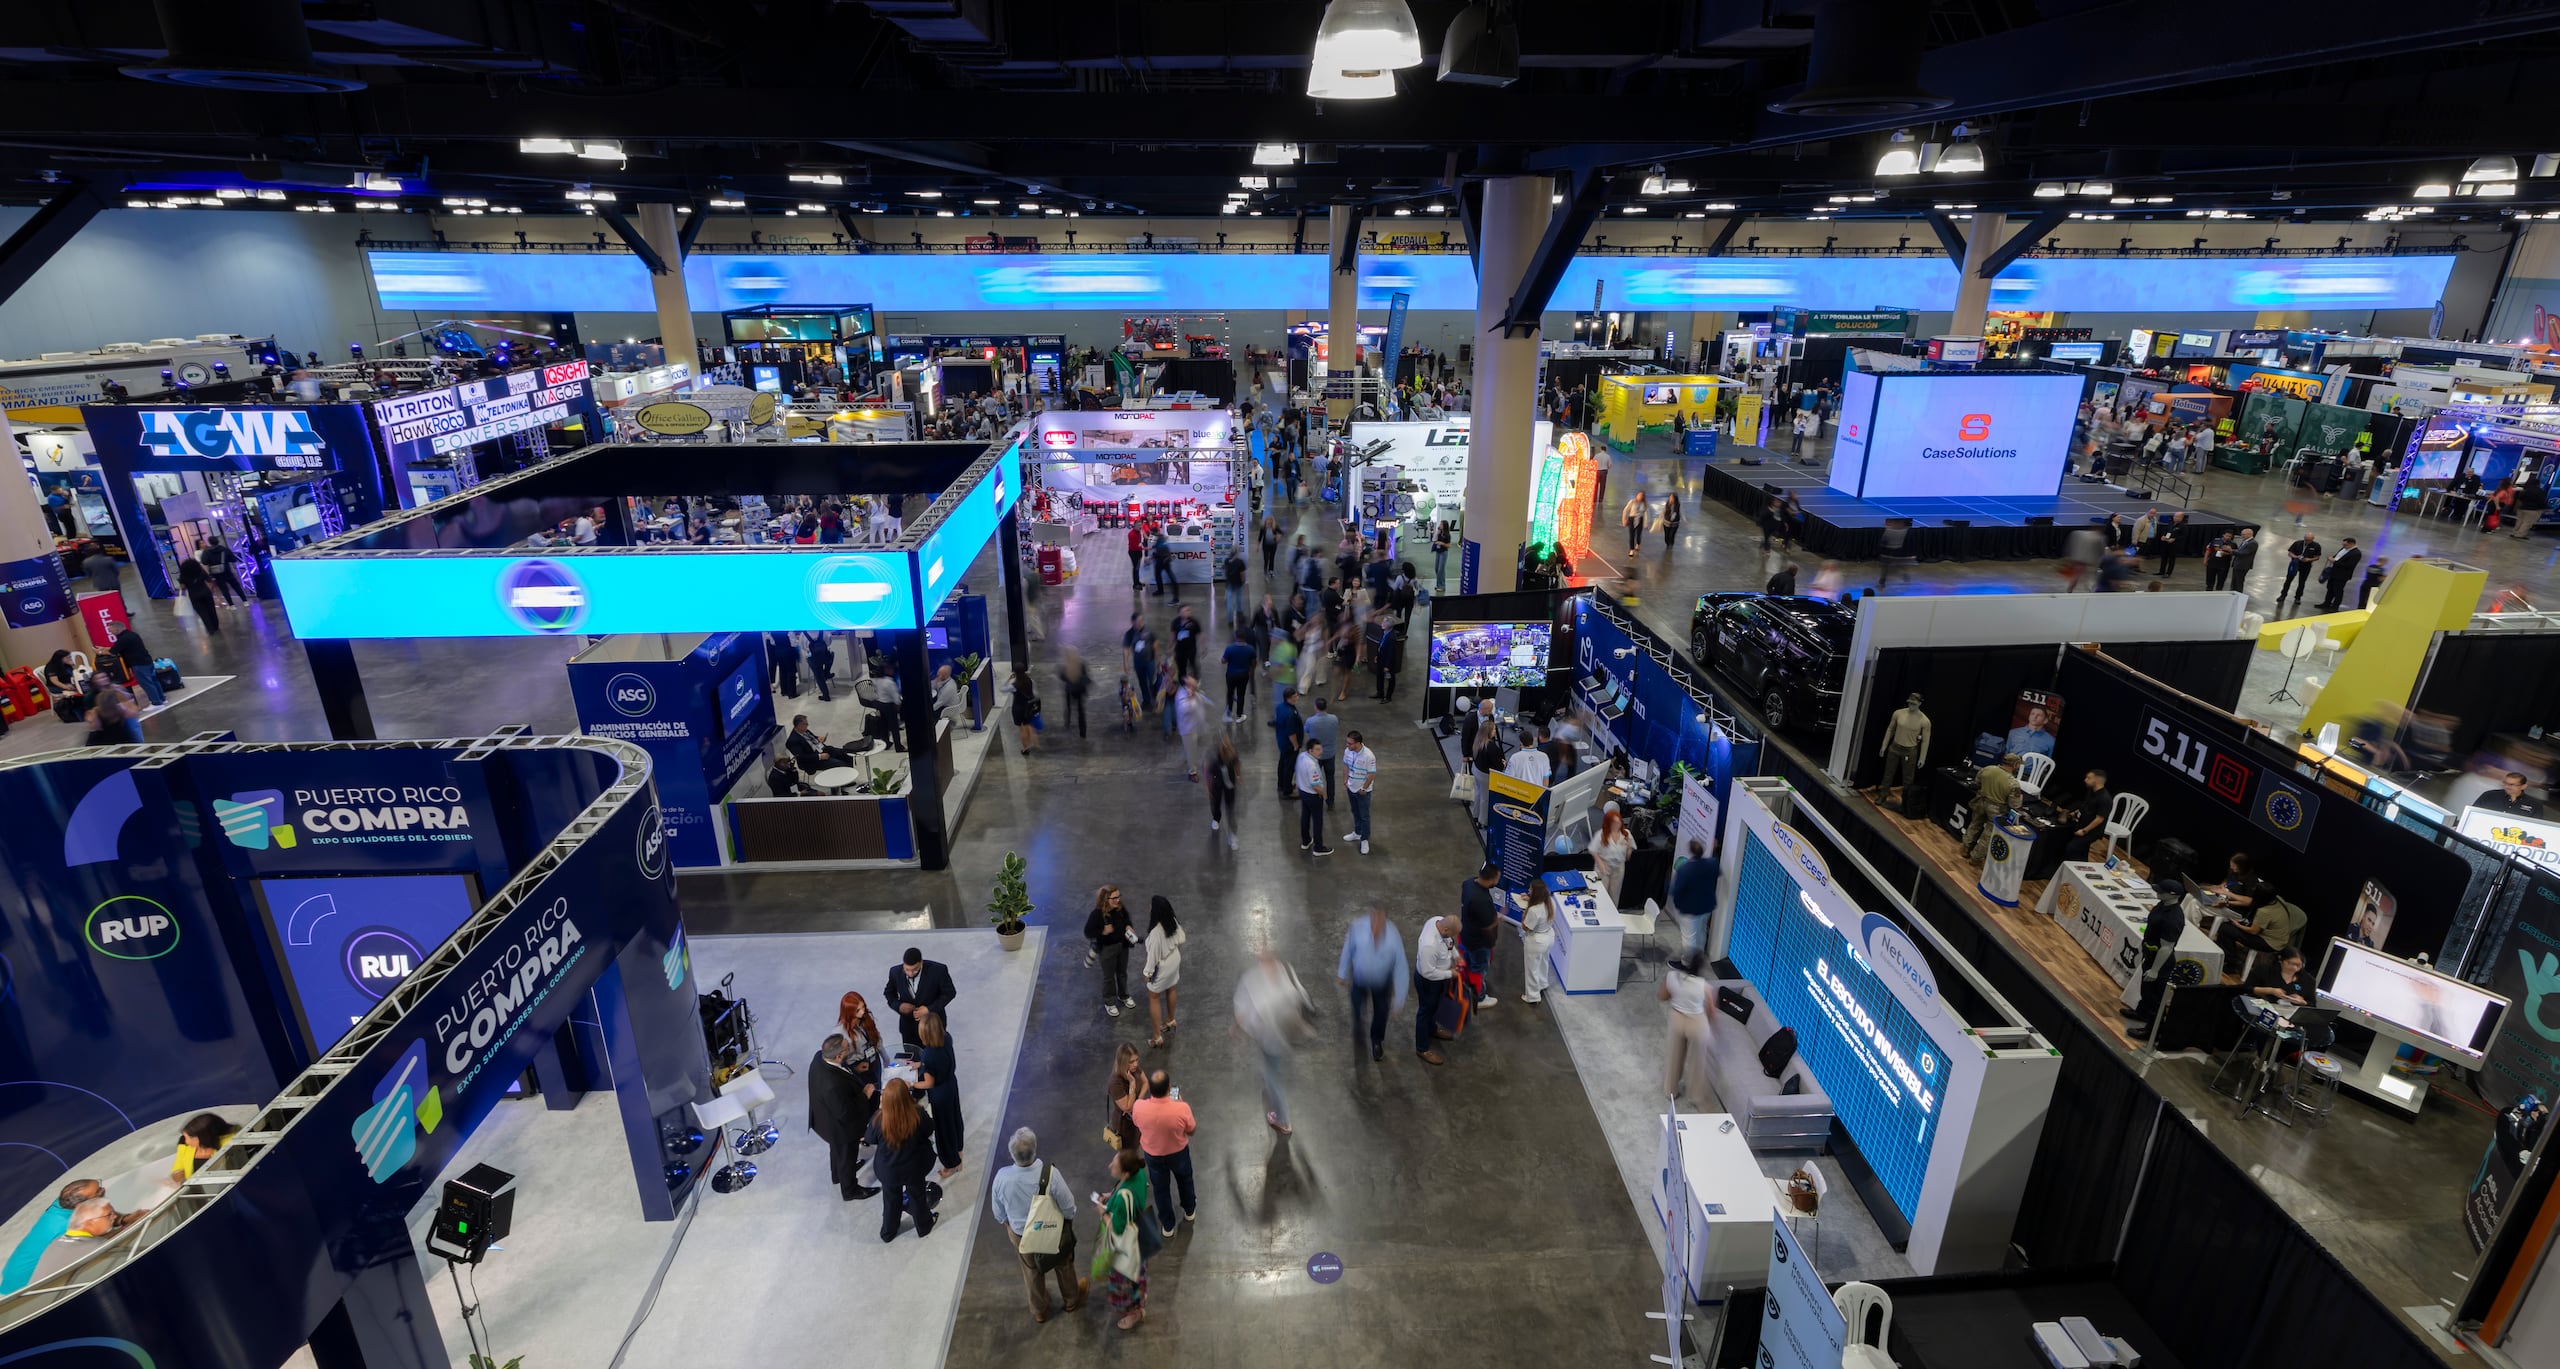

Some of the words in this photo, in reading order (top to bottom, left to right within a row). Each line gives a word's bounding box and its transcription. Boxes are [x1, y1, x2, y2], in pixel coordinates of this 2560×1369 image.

[1391, 236, 1428, 246] MEDALLA
[544, 362, 588, 387] IQSIGHT
[2, 398, 59, 408] MMAND
[65, 393, 100, 404] UNIT
[509, 382, 531, 395] Hytera
[534, 384, 582, 408] MAGOS
[394, 394, 454, 419] TRITON
[486, 398, 530, 418] TELTONIKA
[2173, 399, 2204, 412] Holsum
[434, 405, 566, 453] POWERSTACK
[1922, 447, 2017, 459] CaseSolutions
[12, 578, 48, 589] COMPRA
[24, 601, 42, 610] ASG
[617, 688, 648, 702] ASG
[2022, 690, 2048, 706] 5.11
[589, 721, 674, 733] ADMINISTRACIÓN
[674, 722, 688, 730] DE
[589, 731, 637, 740] SERVICIOS
[638, 729, 690, 738] GENERALES
[2142, 717, 2208, 784] 5.11
[294, 788, 397, 806] PUERTO
[402, 786, 462, 804] RICO
[302, 806, 470, 834] COMPRA
[312, 836, 340, 845] EXPO
[342, 836, 406, 844] SUPLIDORES
[408, 834, 428, 842] DEL
[430, 833, 473, 842] GOBIERN
[646, 824, 663, 858] ASG
[2364, 880, 2382, 907] 5.11
[100, 914, 170, 944] RUP
[2081, 906, 2102, 938] 5.11
[435, 944, 522, 1044] PUERTO
[524, 896, 568, 952] RICO
[1882, 934, 1933, 998] Netwave
[446, 918, 582, 1074] COMPRA
[456, 1064, 482, 1096] EXPO
[482, 1004, 534, 1066] SUPLIDORES
[533, 988, 550, 1008] DEL
[550, 944, 586, 989] GOBIERNO
[1817, 958, 1830, 986] EL
[1830, 974, 1875, 1038] ESCUDO
[1873, 1028, 1934, 1114] INVISIBLE
[1792, 1262, 1824, 1315] Resilient
[1790, 1270, 1840, 1352] International
